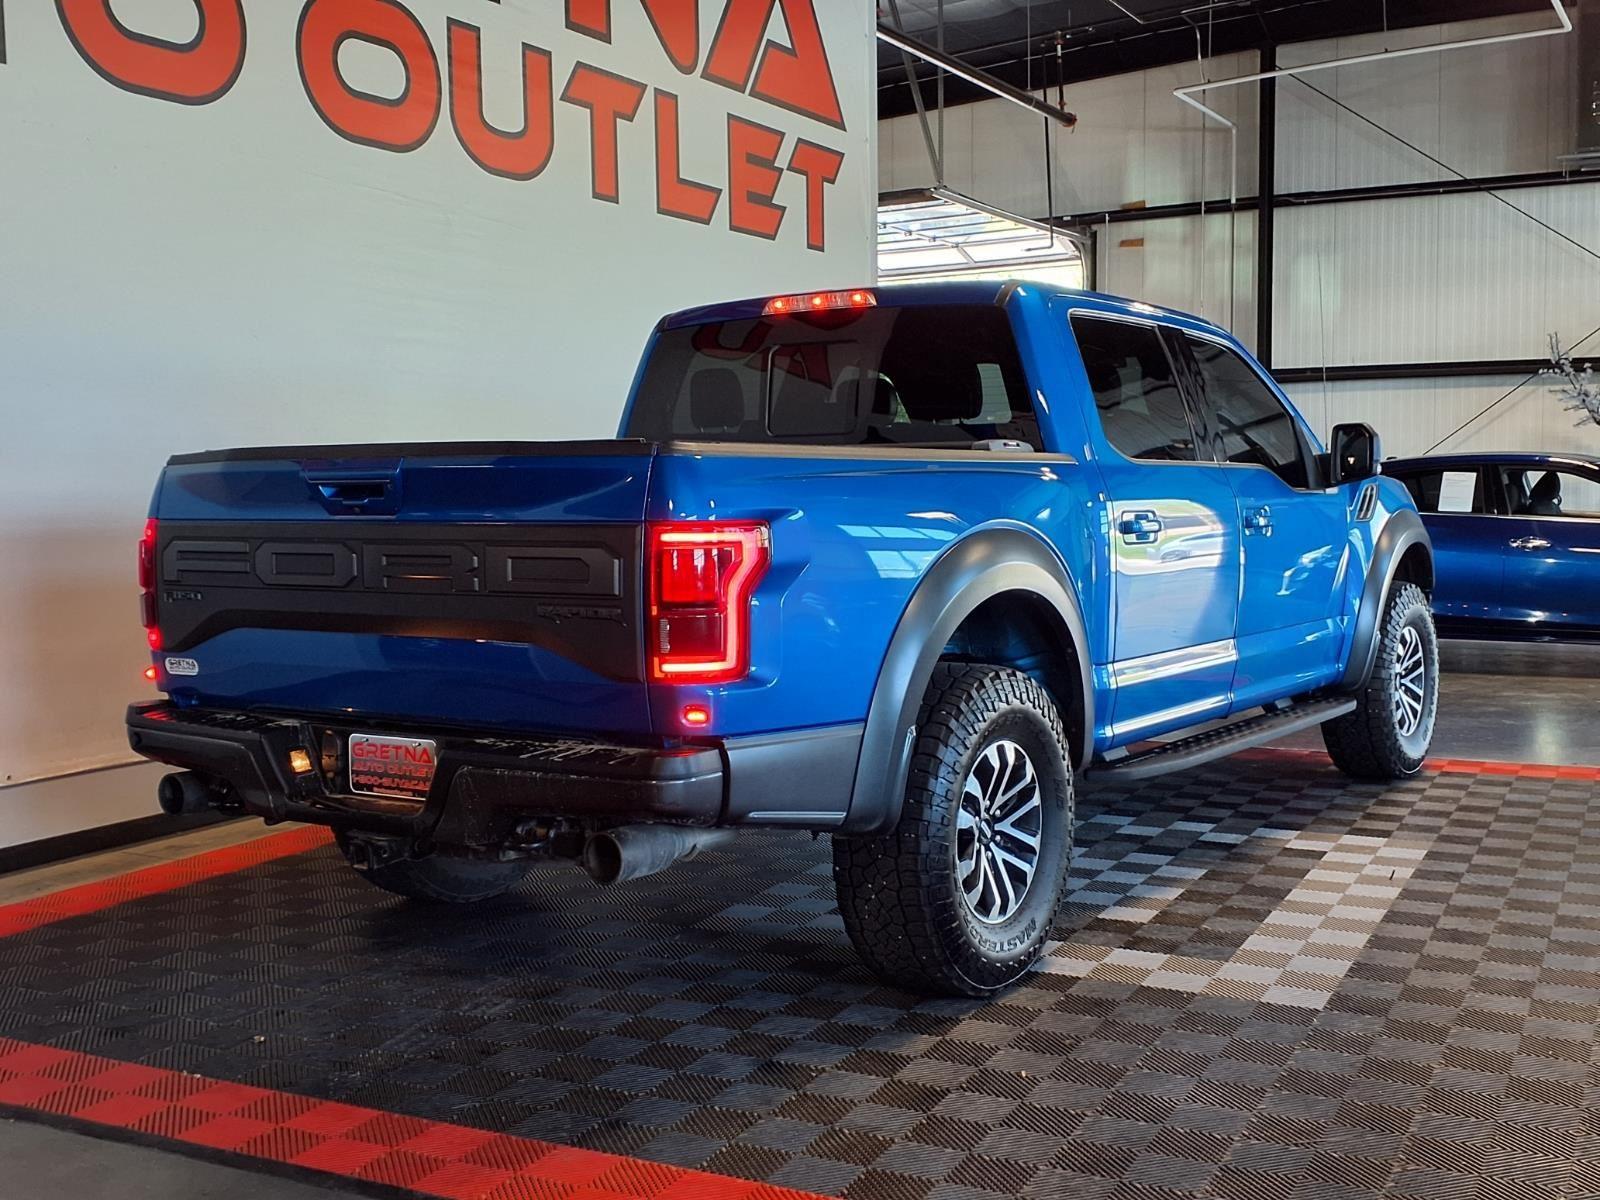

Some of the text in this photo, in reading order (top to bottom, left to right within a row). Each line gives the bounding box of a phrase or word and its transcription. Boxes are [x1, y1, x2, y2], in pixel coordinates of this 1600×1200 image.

[295, 0, 844, 252] OUTLET
[163, 538, 623, 598] FORD
[352, 742, 432, 764] GRETNA
[352, 761, 434, 777] AUTO OUTLET
